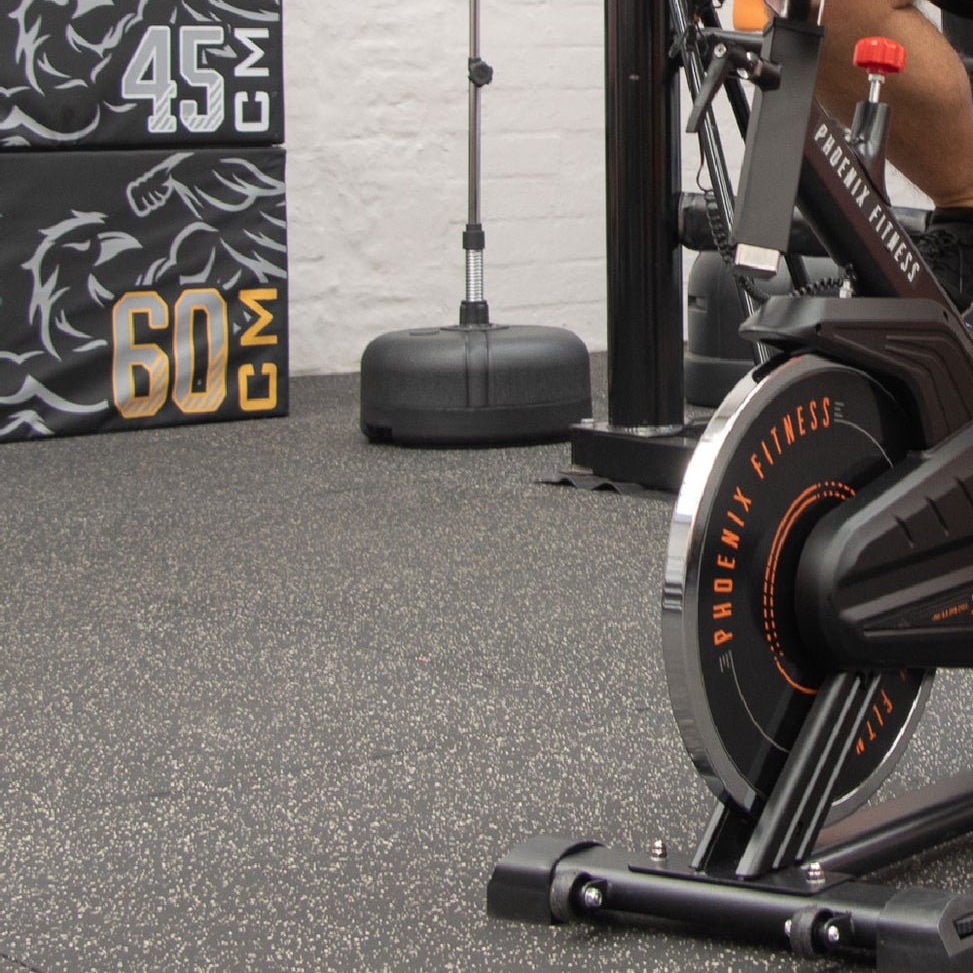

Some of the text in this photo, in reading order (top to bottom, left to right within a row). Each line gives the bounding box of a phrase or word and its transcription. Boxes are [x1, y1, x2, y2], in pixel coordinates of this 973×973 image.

[121, 25, 270, 133] 45 CM
[814, 124, 920, 282] PHOENIX FITNESS
[112, 287, 278, 418] 60 CM
[713, 397, 830, 646] PHOENIX FITNESS
